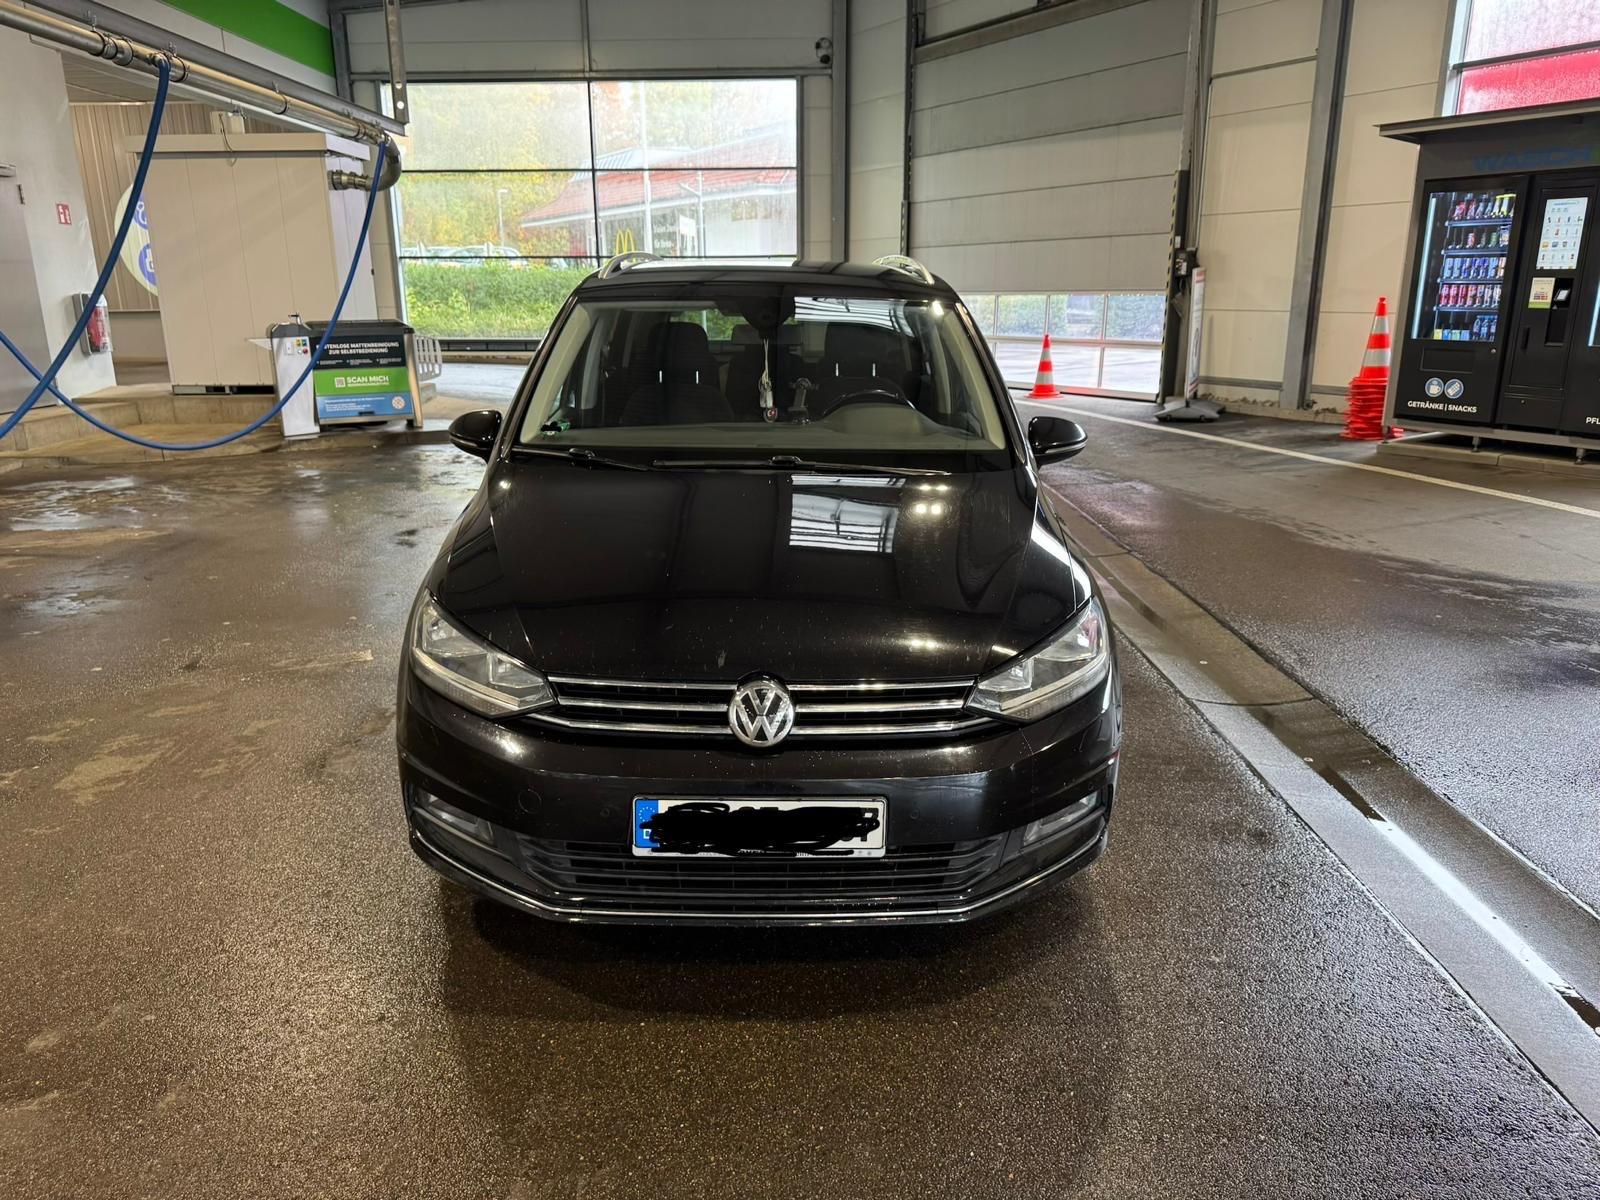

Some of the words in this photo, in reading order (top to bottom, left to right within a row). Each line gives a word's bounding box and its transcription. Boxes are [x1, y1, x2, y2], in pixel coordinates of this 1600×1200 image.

[346, 376, 368, 384] SCAN
[369, 375, 389, 383] MICH
[1407, 400, 1444, 410] GETRÄNKE
[1448, 404, 1478, 413] SNACKS
